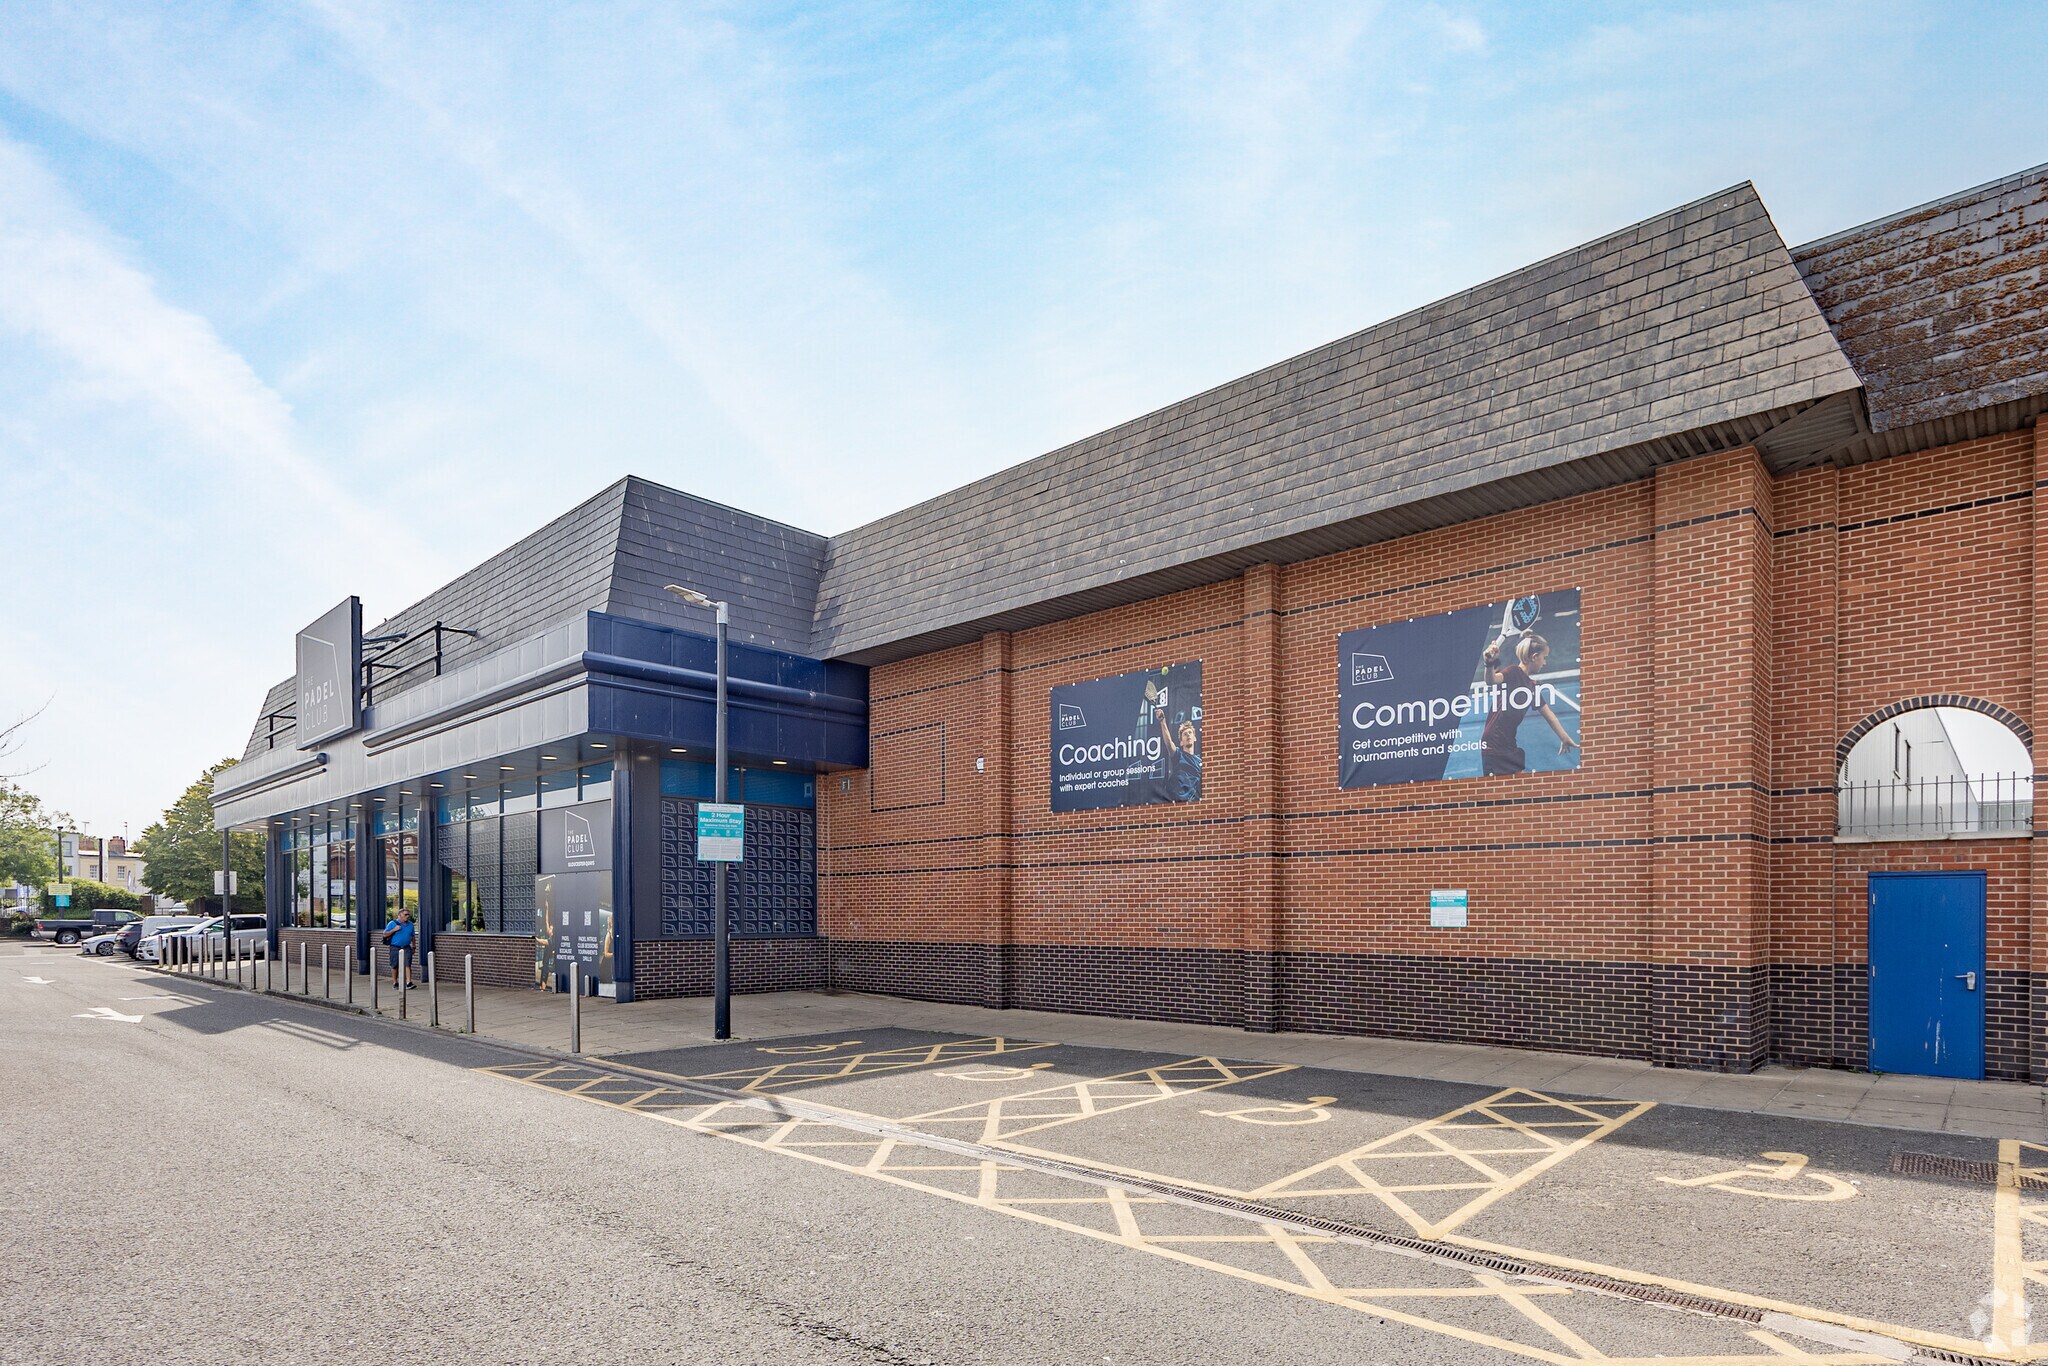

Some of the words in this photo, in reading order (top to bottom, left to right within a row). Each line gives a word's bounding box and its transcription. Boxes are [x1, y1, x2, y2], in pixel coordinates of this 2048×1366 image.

[1355, 672, 1378, 681] CLUB
[1356, 666, 1384, 675] PADEL
[305, 676, 313, 688] THE
[305, 680, 334, 710] PADEL
[1352, 682, 1556, 730] Competition
[305, 704, 328, 730] CLUB
[1352, 738, 1371, 750] Get
[1374, 732, 1436, 747] competitive
[1439, 728, 1462, 740] with
[1059, 736, 1161, 766] Coaching
[1353, 747, 1419, 763] tournaments
[1422, 744, 1444, 756] and
[1447, 740, 1488, 753] socials
[1060, 771, 1092, 782] Individual
[1102, 768, 1124, 779] group
[1126, 765, 1156, 774] sessions
[1060, 783, 1073, 792] with
[1074, 781, 1096, 791] expert
[1097, 779, 1129, 788] coaches
[568, 834, 587, 844] PADEL
[568, 844, 584, 853] CLUB
